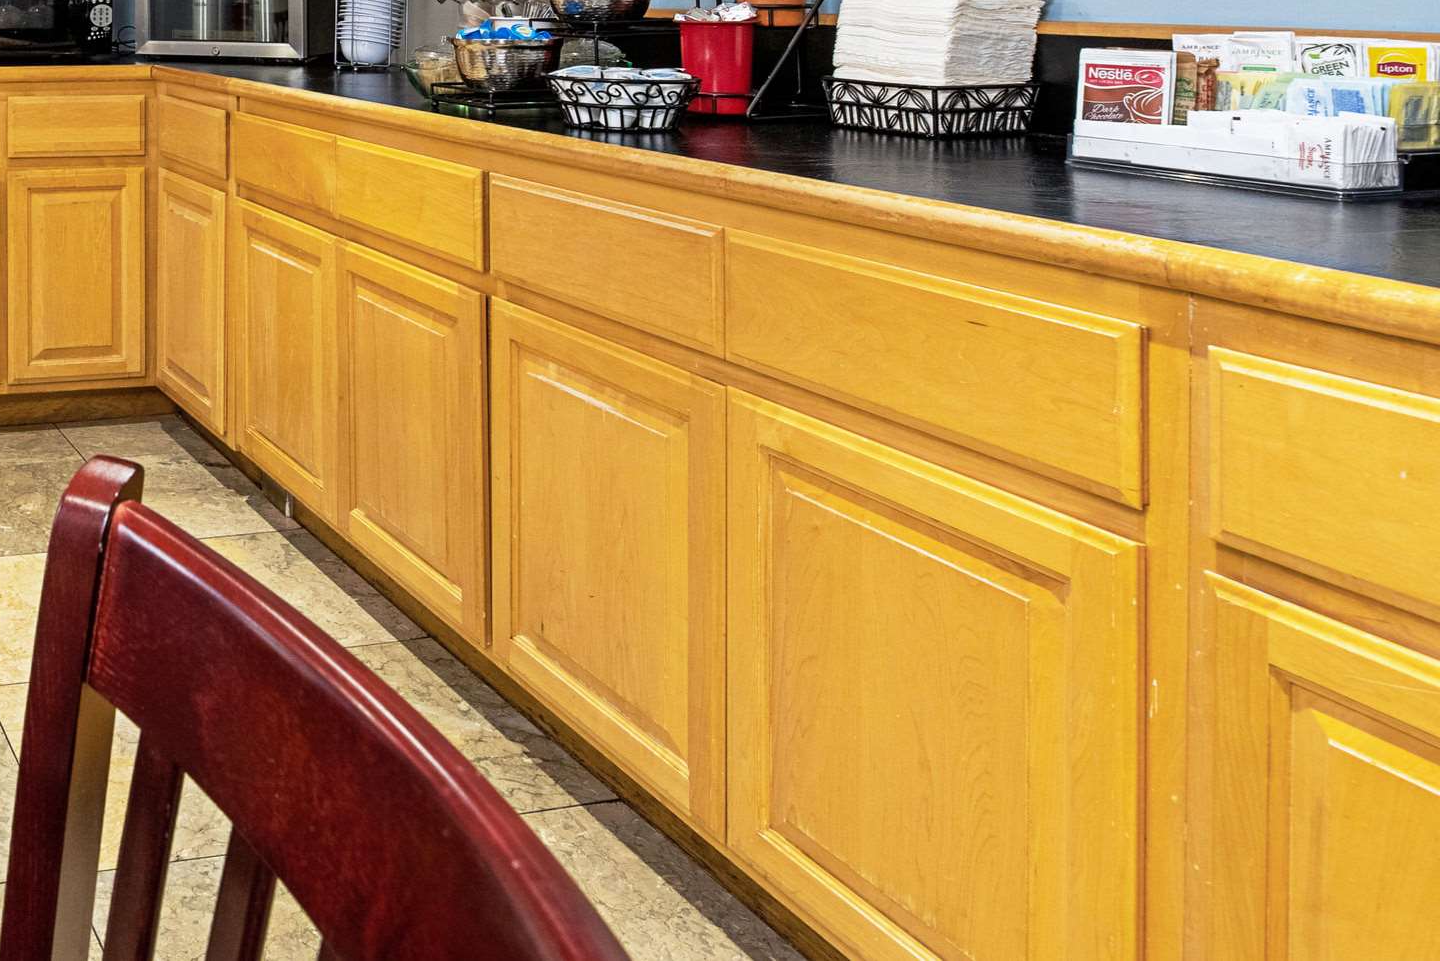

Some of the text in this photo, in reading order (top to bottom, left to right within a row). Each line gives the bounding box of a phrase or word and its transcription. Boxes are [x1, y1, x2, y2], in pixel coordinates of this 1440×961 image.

[1311, 60, 1350, 75] GREEN
[1379, 64, 1414, 74] Lipton
[1092, 103, 1120, 114] Dark
